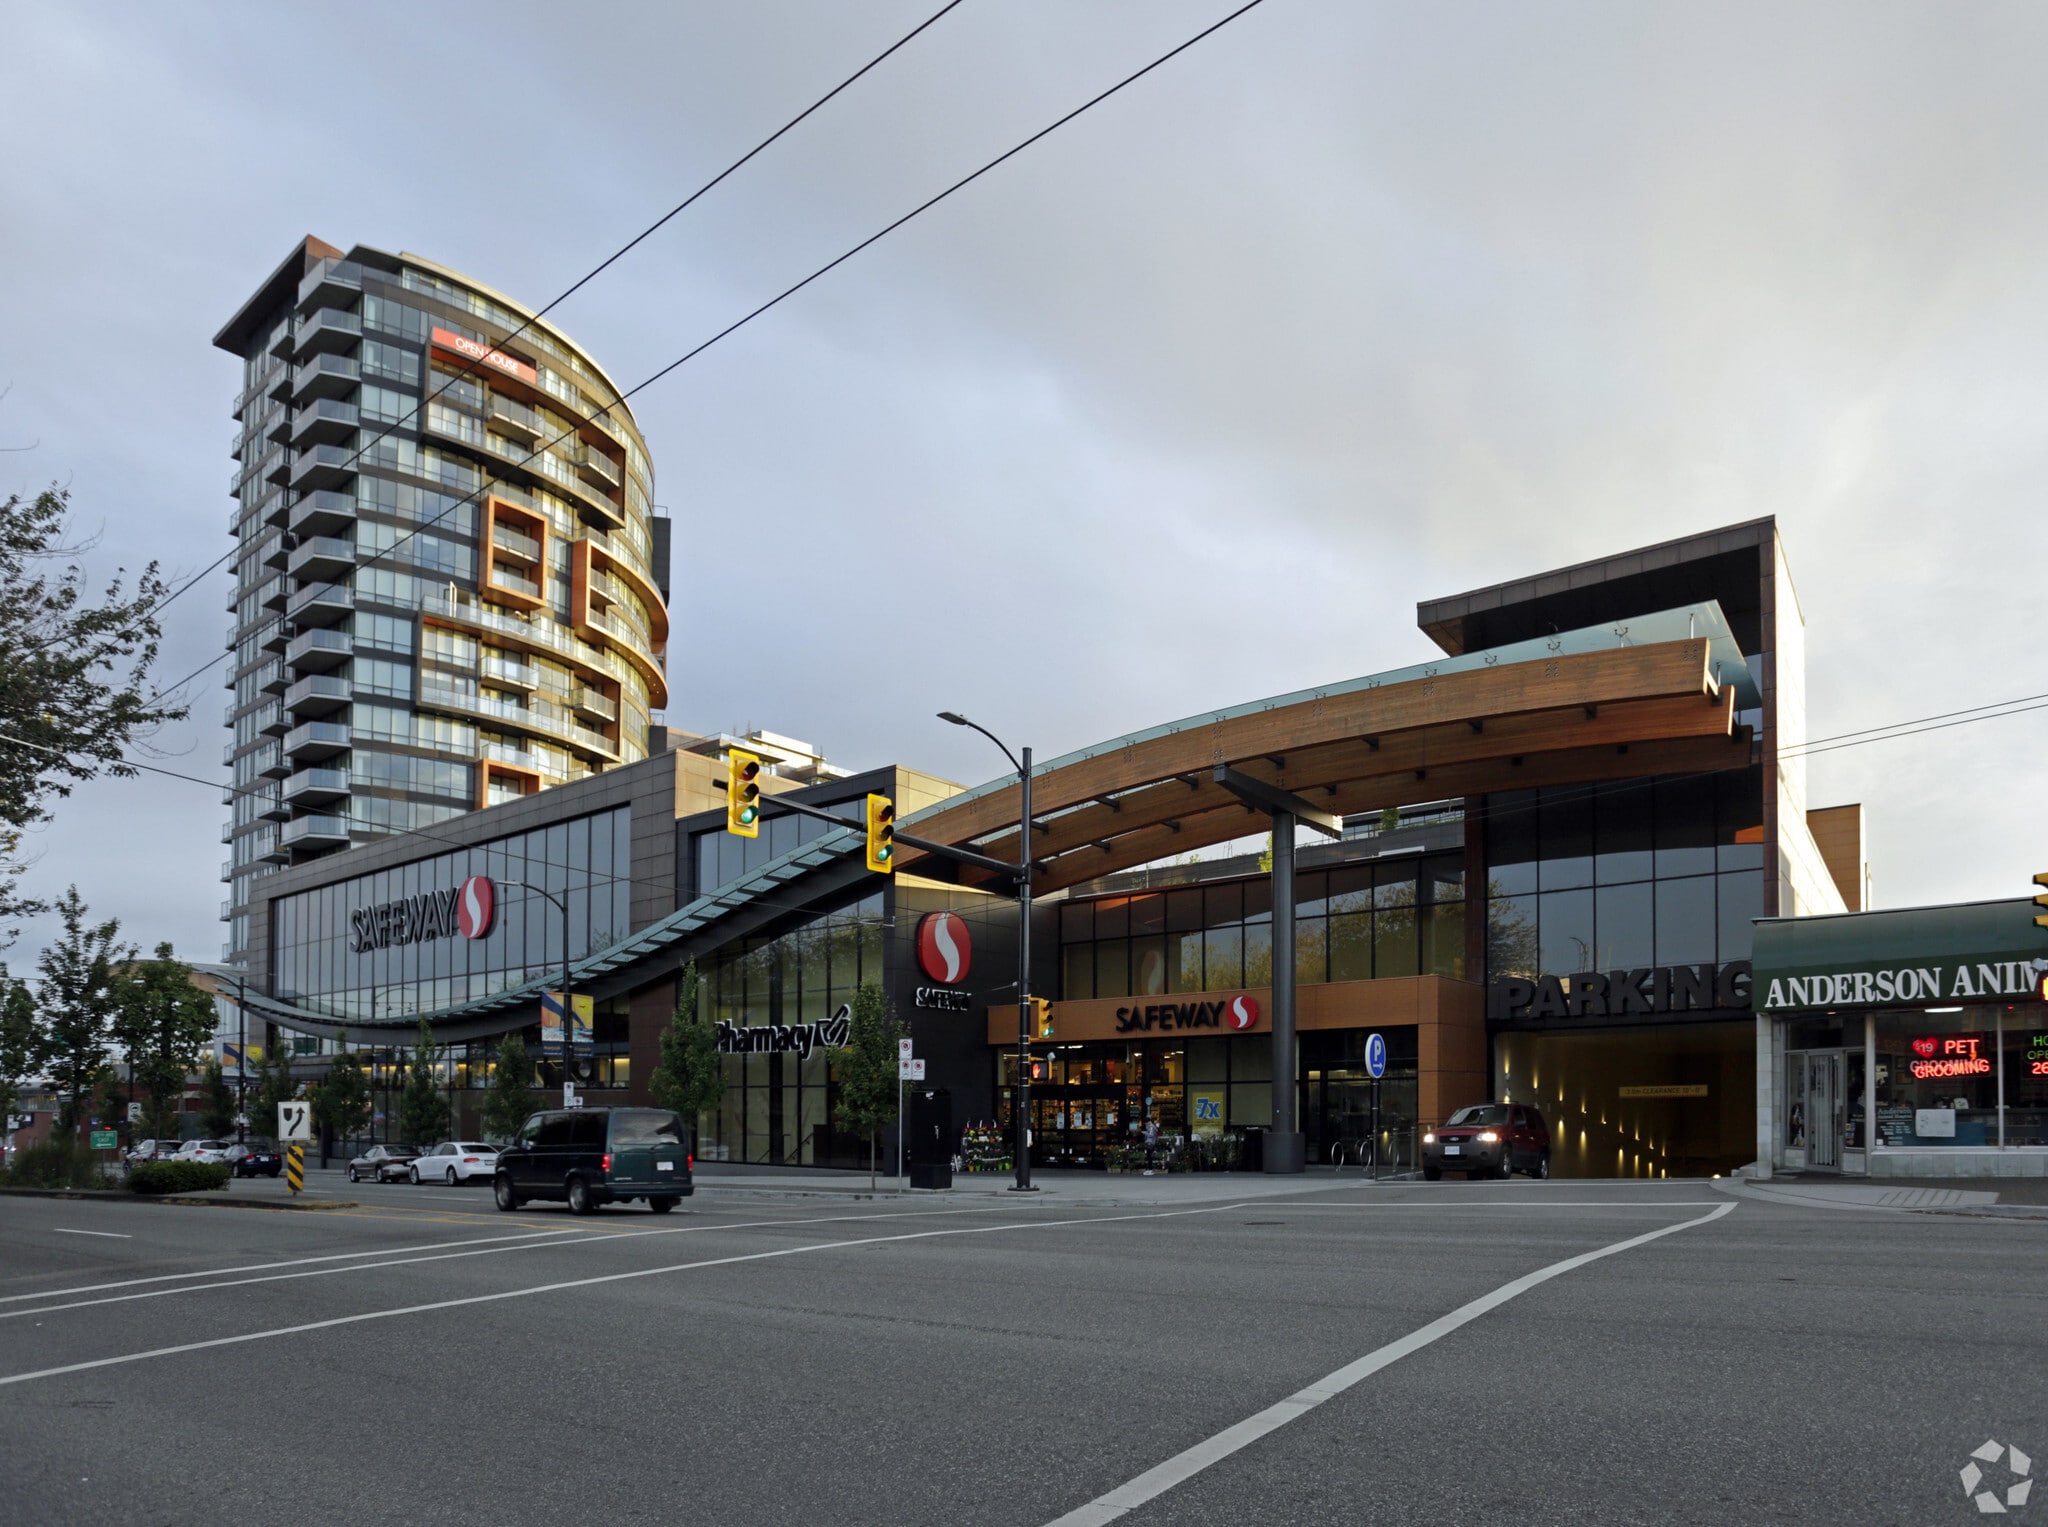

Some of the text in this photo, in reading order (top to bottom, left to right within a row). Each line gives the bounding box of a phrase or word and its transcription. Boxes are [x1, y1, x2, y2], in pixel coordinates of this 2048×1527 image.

[455, 338, 519, 373] OPEN HOUSE
[350, 887, 460, 953] SAFEWAY
[1487, 960, 1752, 1020] PARKING
[1765, 967, 1942, 1008] ANDERSON
[1115, 1001, 1226, 1033] SAFEWAY
[714, 1018, 816, 1061] Pharmacy
[1373, 1040, 1382, 1062] P
[1945, 1040, 1980, 1054] PET
[1913, 1058, 1990, 1079] GROOMING
